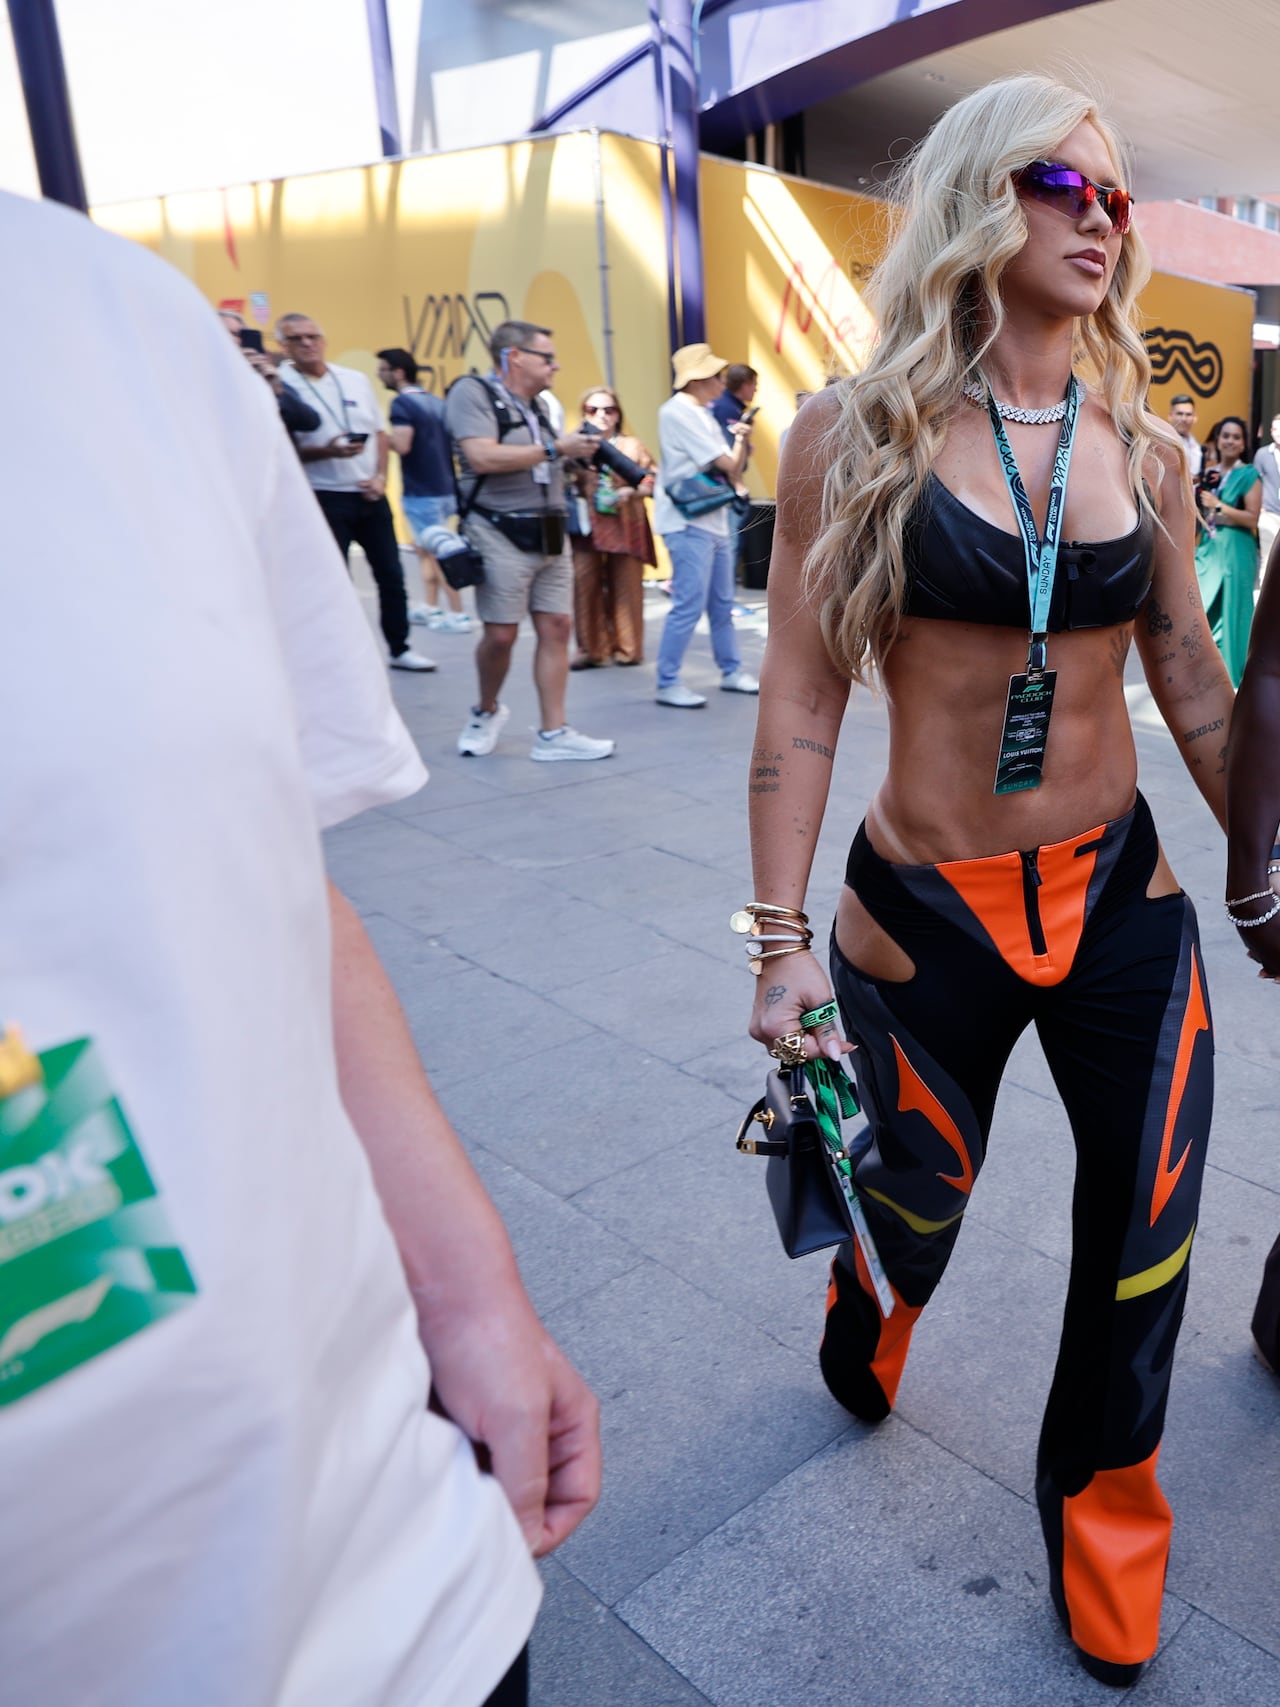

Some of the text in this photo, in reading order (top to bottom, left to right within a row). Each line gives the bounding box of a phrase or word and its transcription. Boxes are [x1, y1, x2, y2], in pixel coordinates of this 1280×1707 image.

[1040, 554, 1052, 595] SUNDAY
[1010, 690, 1053, 701] PADDOCK
[1020, 695, 1043, 704] CLUB
[1002, 751, 1020, 759] LOUIS
